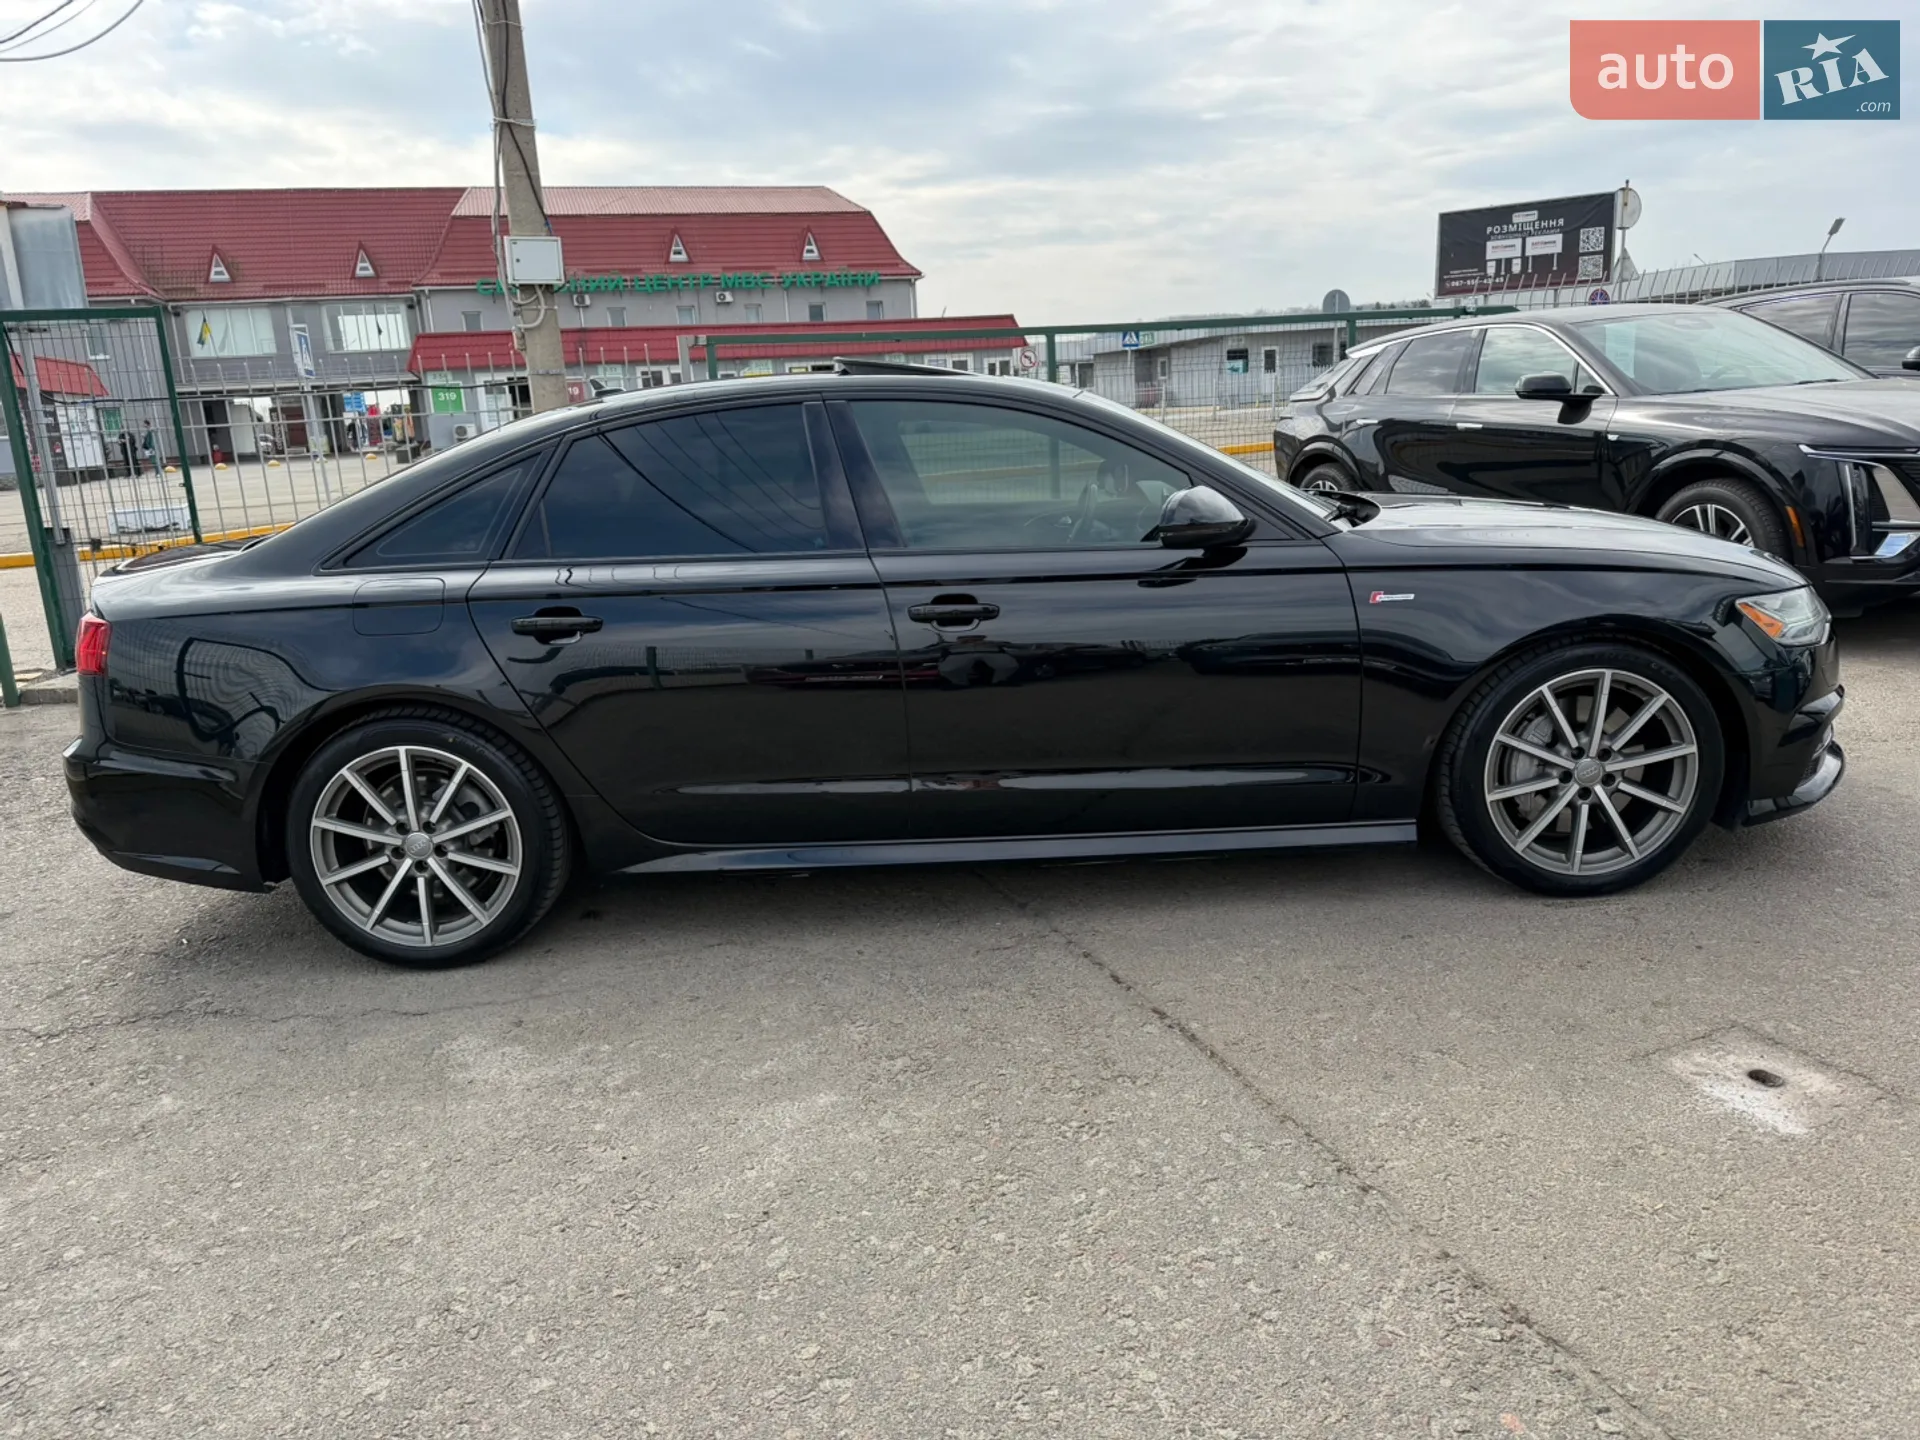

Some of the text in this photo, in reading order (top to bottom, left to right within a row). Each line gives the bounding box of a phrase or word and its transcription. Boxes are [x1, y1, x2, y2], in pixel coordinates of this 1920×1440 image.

[1486, 218, 1565, 235] РОЗМІЩЕННЯ
[634, 274, 714, 294] ЦЕНТР
[721, 273, 772, 290] МВС
[781, 267, 882, 290] УКРАЇНИ
[438, 391, 457, 402] 319
